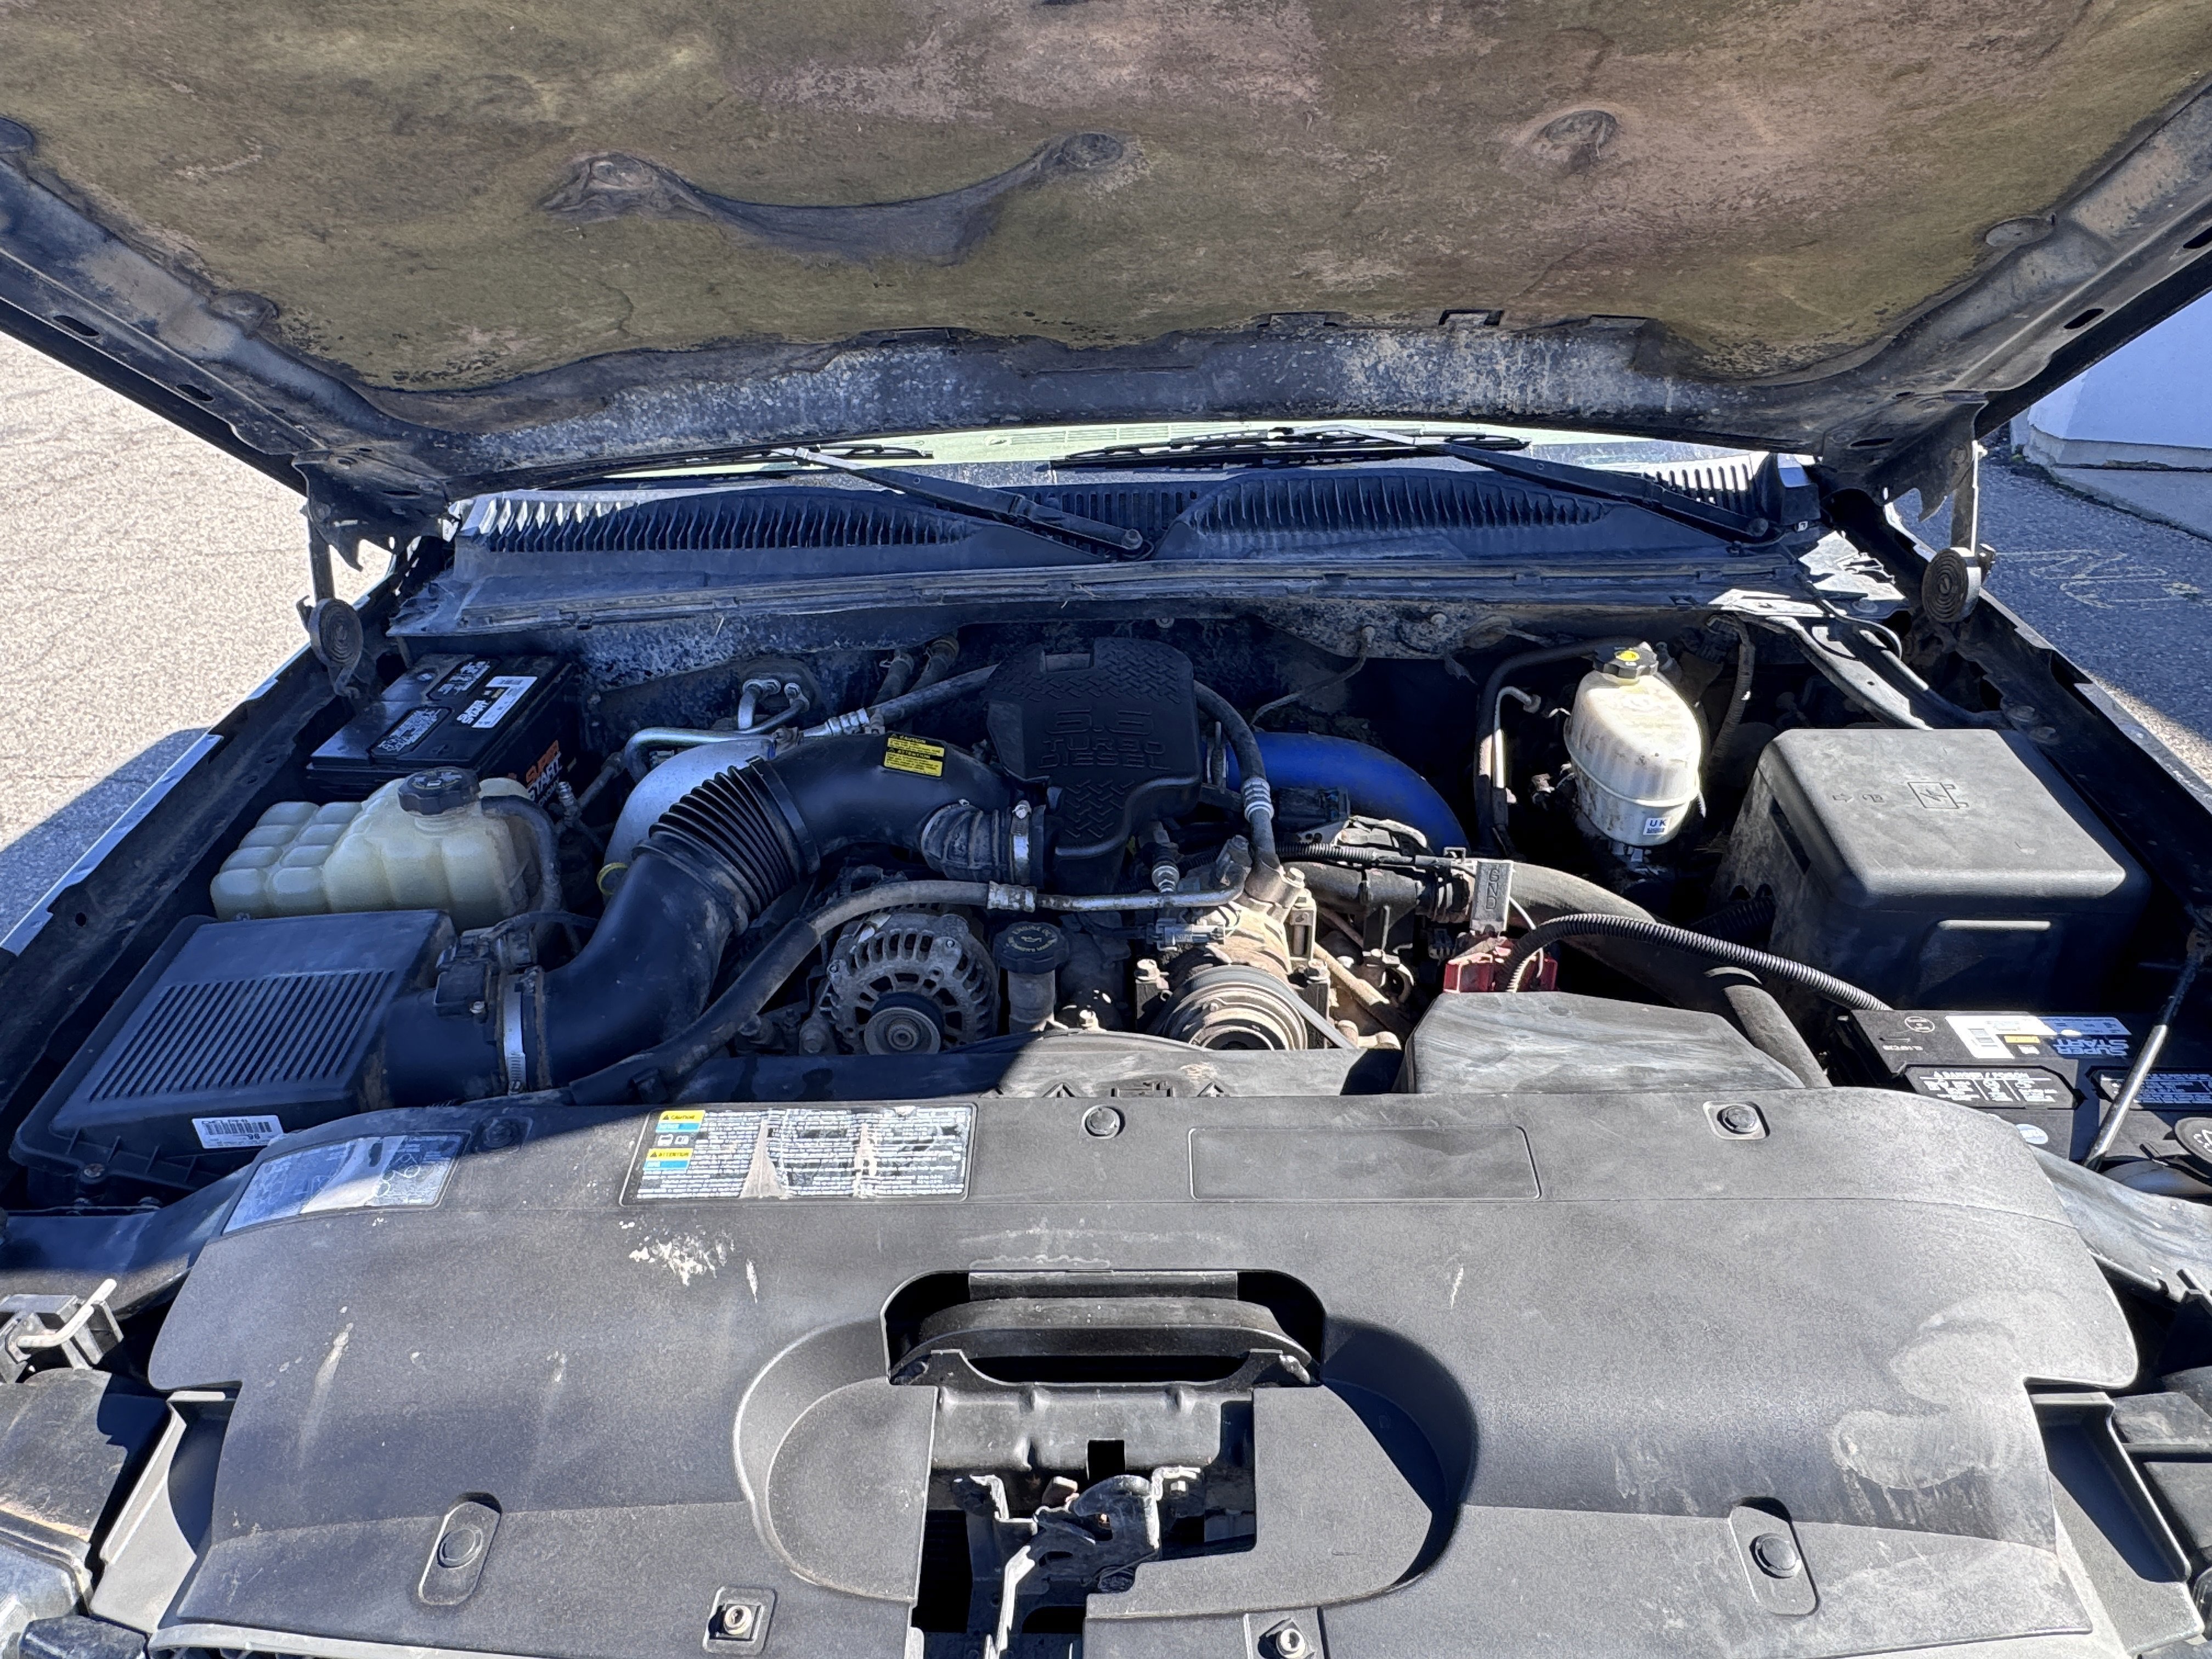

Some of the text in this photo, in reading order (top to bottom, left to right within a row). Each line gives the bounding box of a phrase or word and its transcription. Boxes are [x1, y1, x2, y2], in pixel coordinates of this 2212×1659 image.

[1042, 736, 1166, 755] TURBO
[1037, 752, 1171, 770] DIESEL
[1486, 868, 1500, 910] GND
[2053, 1039, 2129, 1048] START
[2056, 1047, 2129, 1056] SUPER
